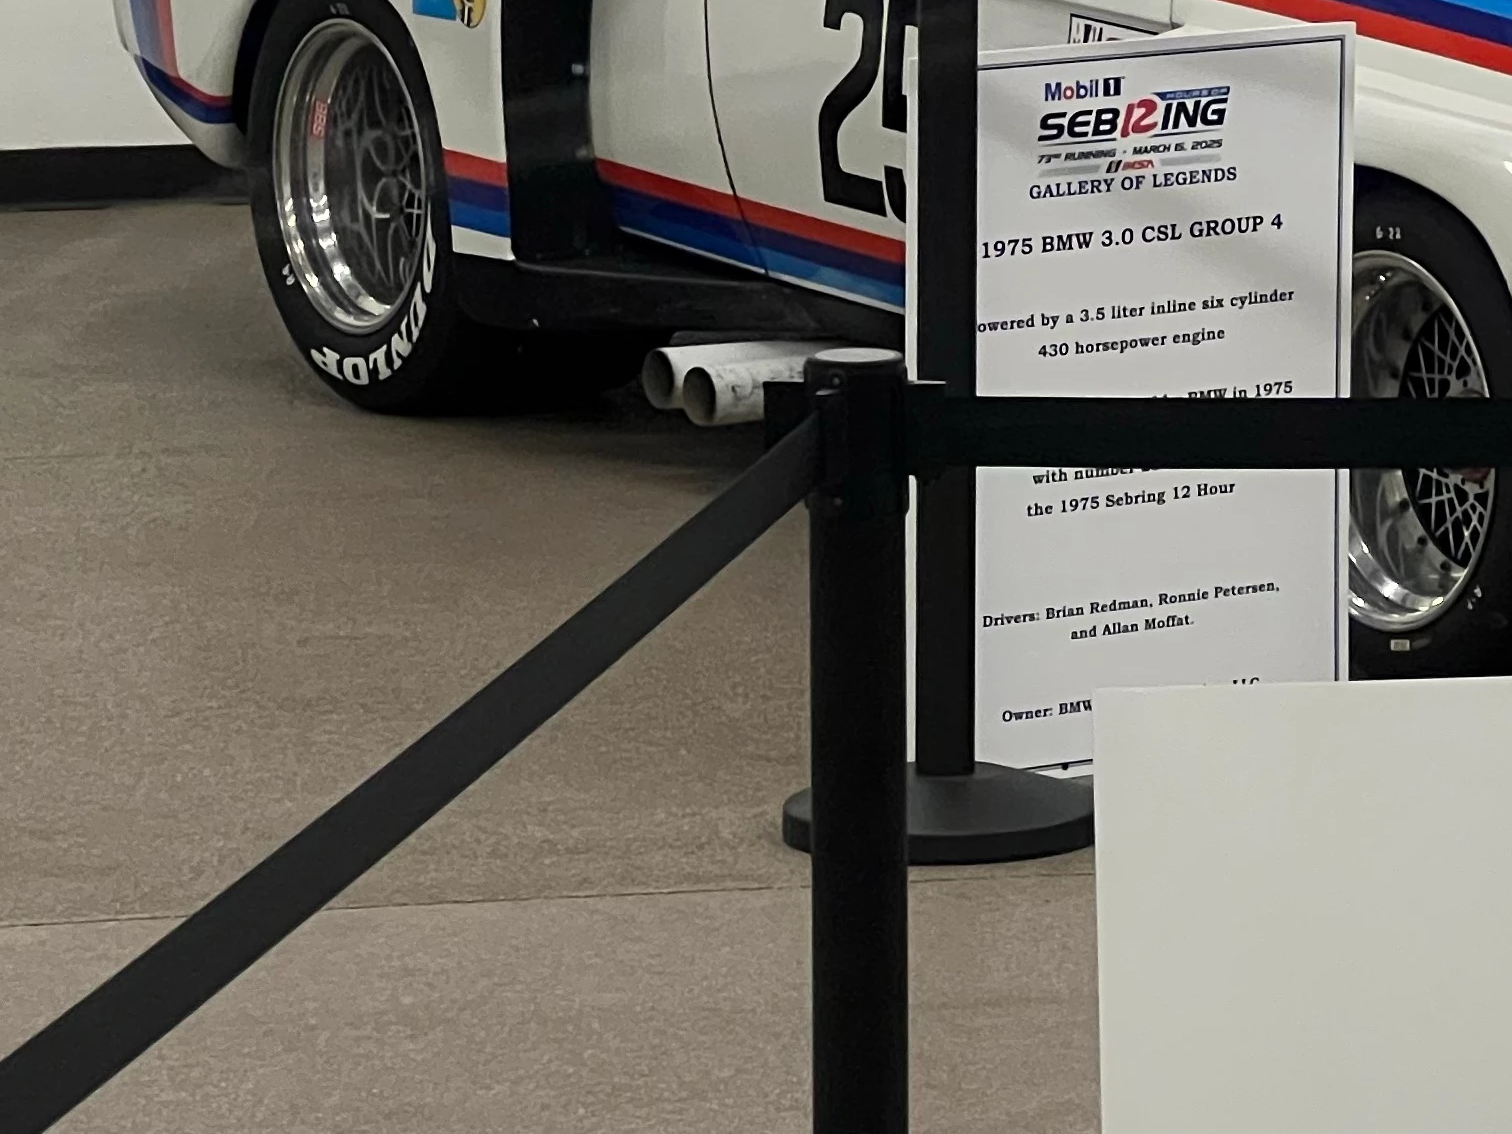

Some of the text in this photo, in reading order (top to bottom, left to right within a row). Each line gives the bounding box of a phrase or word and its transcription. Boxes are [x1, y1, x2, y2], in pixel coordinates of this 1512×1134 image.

[1044, 79, 1099, 102] Mobil
[1132, 143, 1171, 156] MARCH
[1191, 138, 1223, 151] 2025
[1029, 166, 1238, 200] GALLERY OF LEGENDS
[981, 213, 1283, 259] 1975 BMW 3.0 CSL GROUP 4
[310, 201, 437, 386] DUNLOP
[977, 288, 1295, 333] owered by a 3.5 liter inline six cylinder
[1038, 327, 1226, 358] 430 horsepower engine
[1255, 380, 1293, 397] 1975
[1032, 468, 1068, 484] with
[1027, 482, 1236, 517] the 1975 Sebring 12 Hour
[982, 612, 1040, 628] Drivers:
[1045, 606, 1085, 621] Brian
[1090, 597, 1154, 615] Redman,
[1158, 588, 1210, 606] Ronnie
[1070, 613, 1196, 640] and Allan Moffat.
[1001, 706, 1054, 723] Owner:
